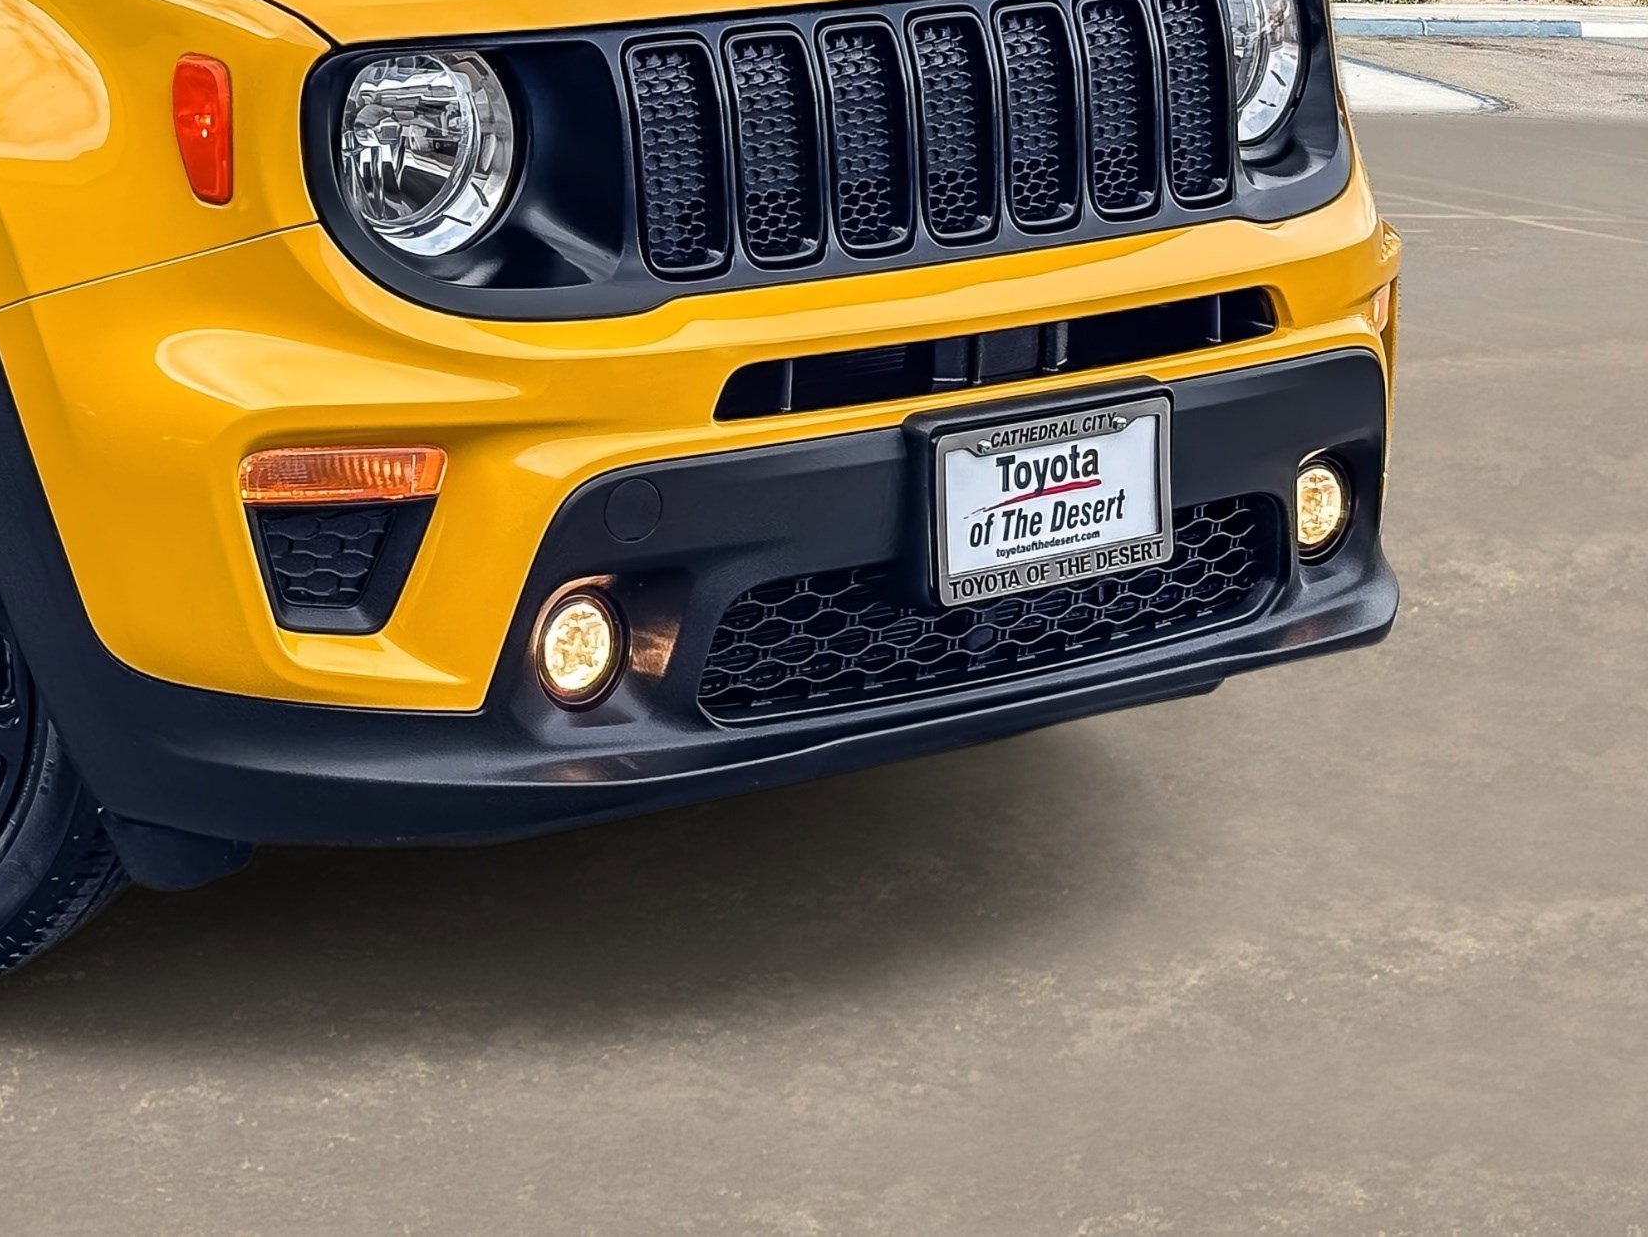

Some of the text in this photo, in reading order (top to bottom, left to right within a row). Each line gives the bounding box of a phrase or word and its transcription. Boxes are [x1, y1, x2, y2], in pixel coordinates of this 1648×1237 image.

[990, 412, 1118, 449] CATHEDRAL CITY
[995, 444, 1100, 493] Toyota
[969, 488, 1126, 548] of The Desert
[995, 530, 1101, 559] toyotaofthedesert.com
[949, 540, 1165, 600] TOYOTA OF THE DESERT
